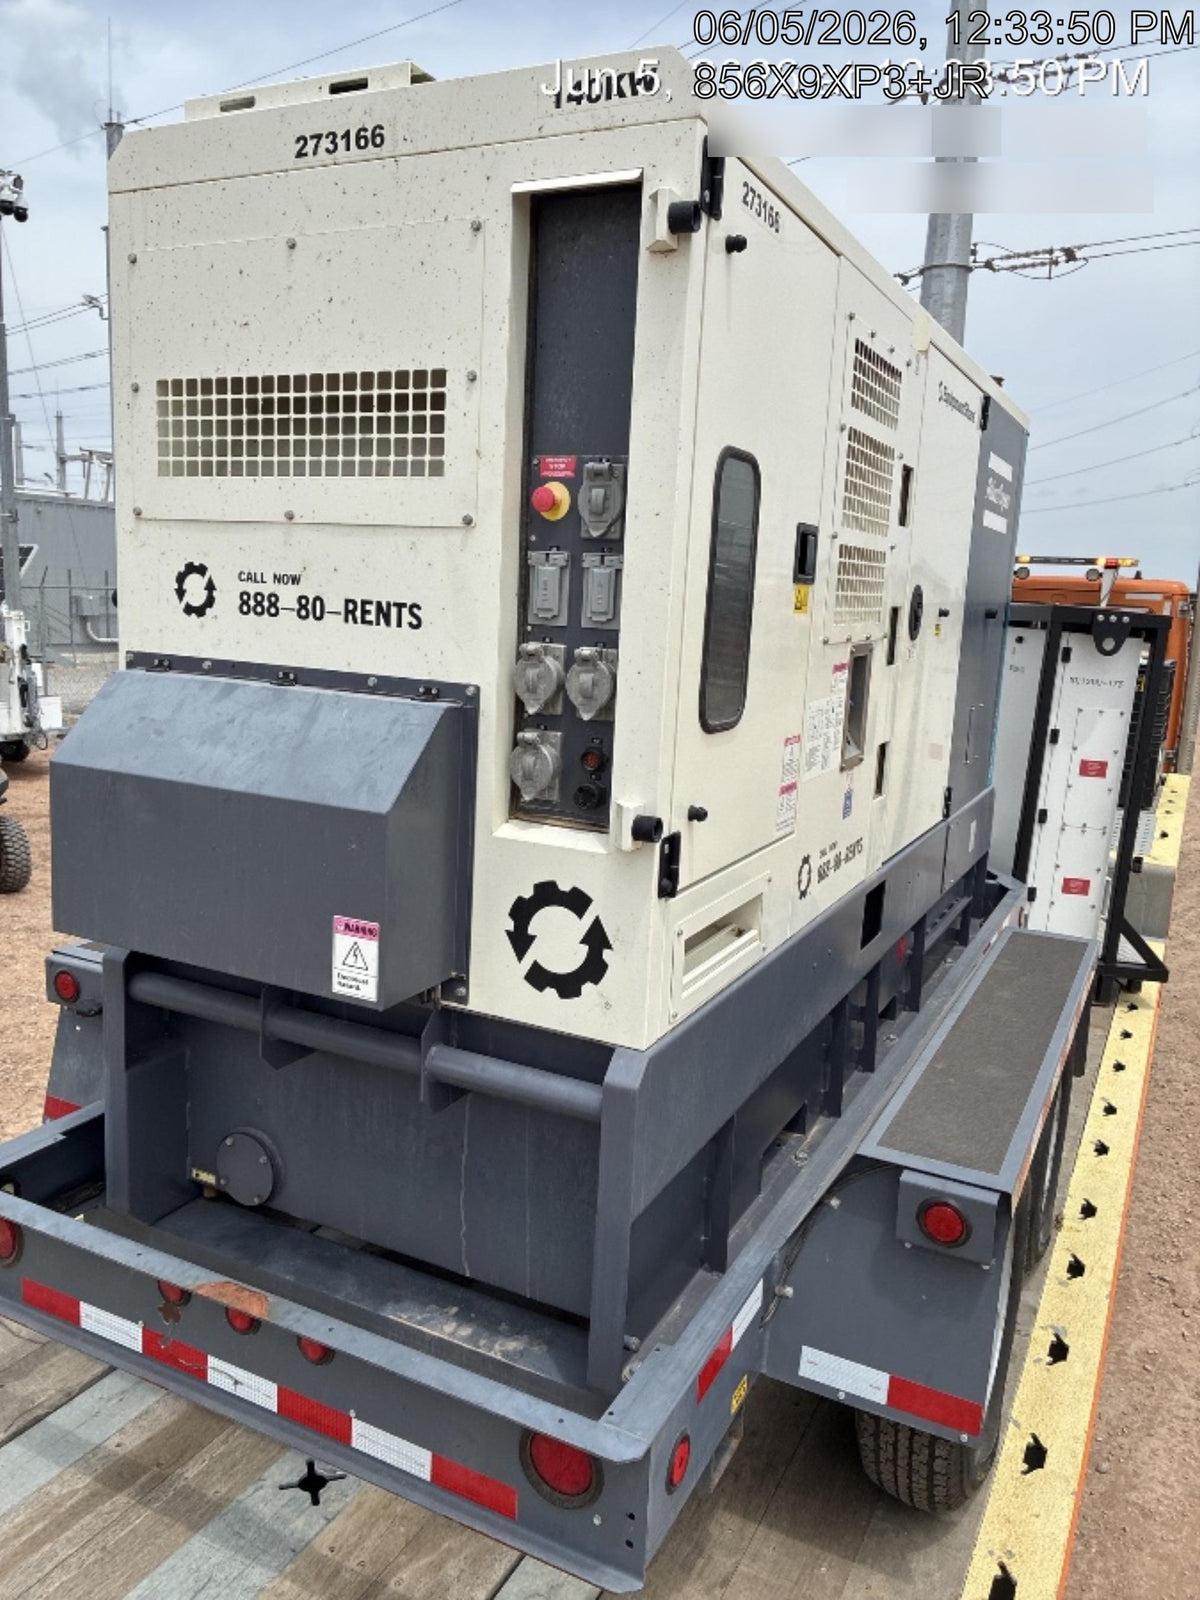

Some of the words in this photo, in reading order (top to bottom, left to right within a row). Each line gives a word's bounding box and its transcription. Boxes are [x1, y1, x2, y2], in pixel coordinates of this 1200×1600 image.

[294, 123, 385, 159] 273166
[742, 180, 780, 233] 273166
[238, 570, 268, 584] CALL
[273, 573, 302, 586] NOW
[238, 590, 423, 630] 888-80-RENTS
